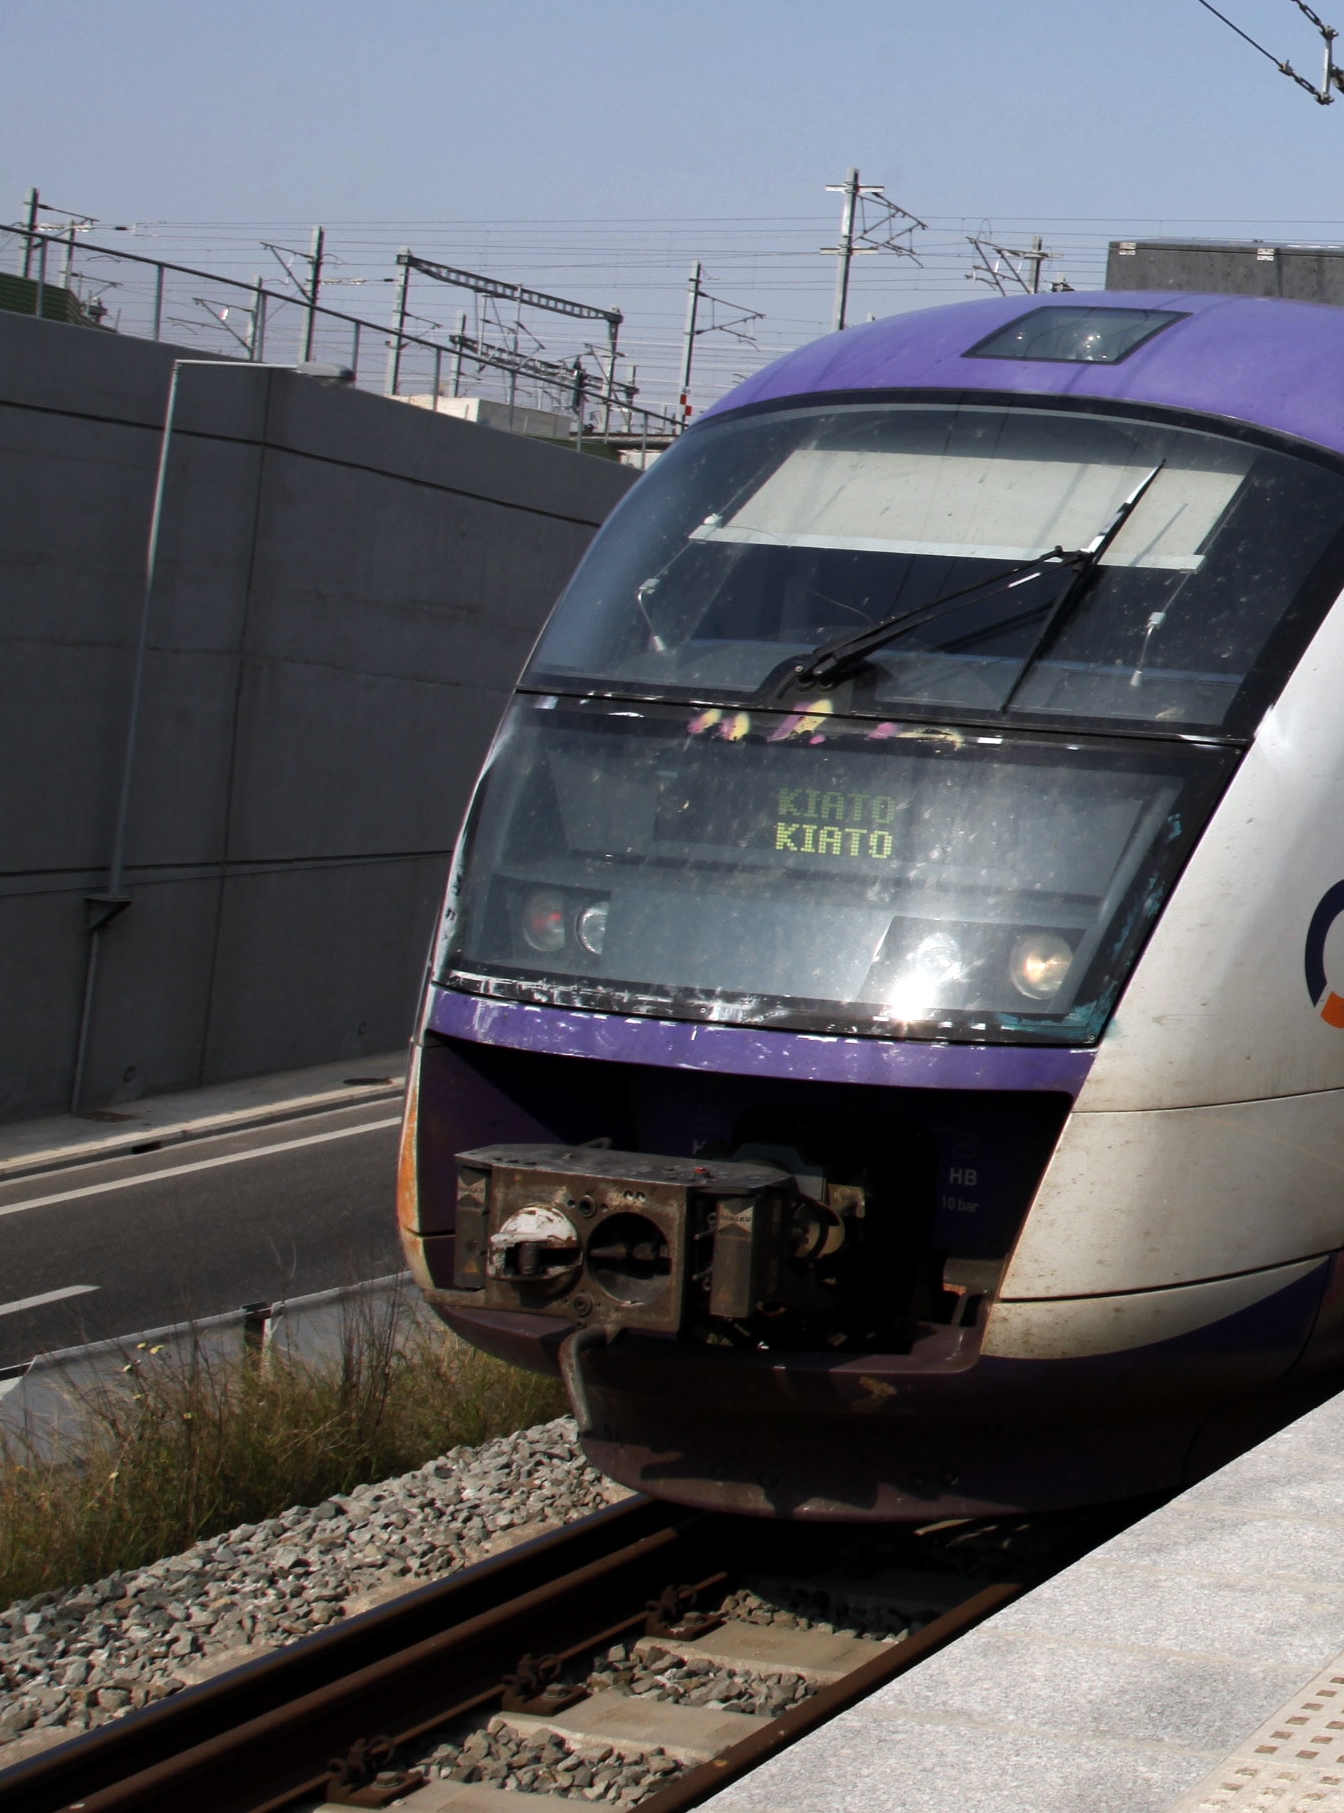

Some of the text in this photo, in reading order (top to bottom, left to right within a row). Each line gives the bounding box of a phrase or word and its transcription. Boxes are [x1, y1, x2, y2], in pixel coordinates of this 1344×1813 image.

[778, 788, 896, 824] KIATO
[774, 822, 893, 859] KIATO
[948, 1165, 979, 1187] HB
